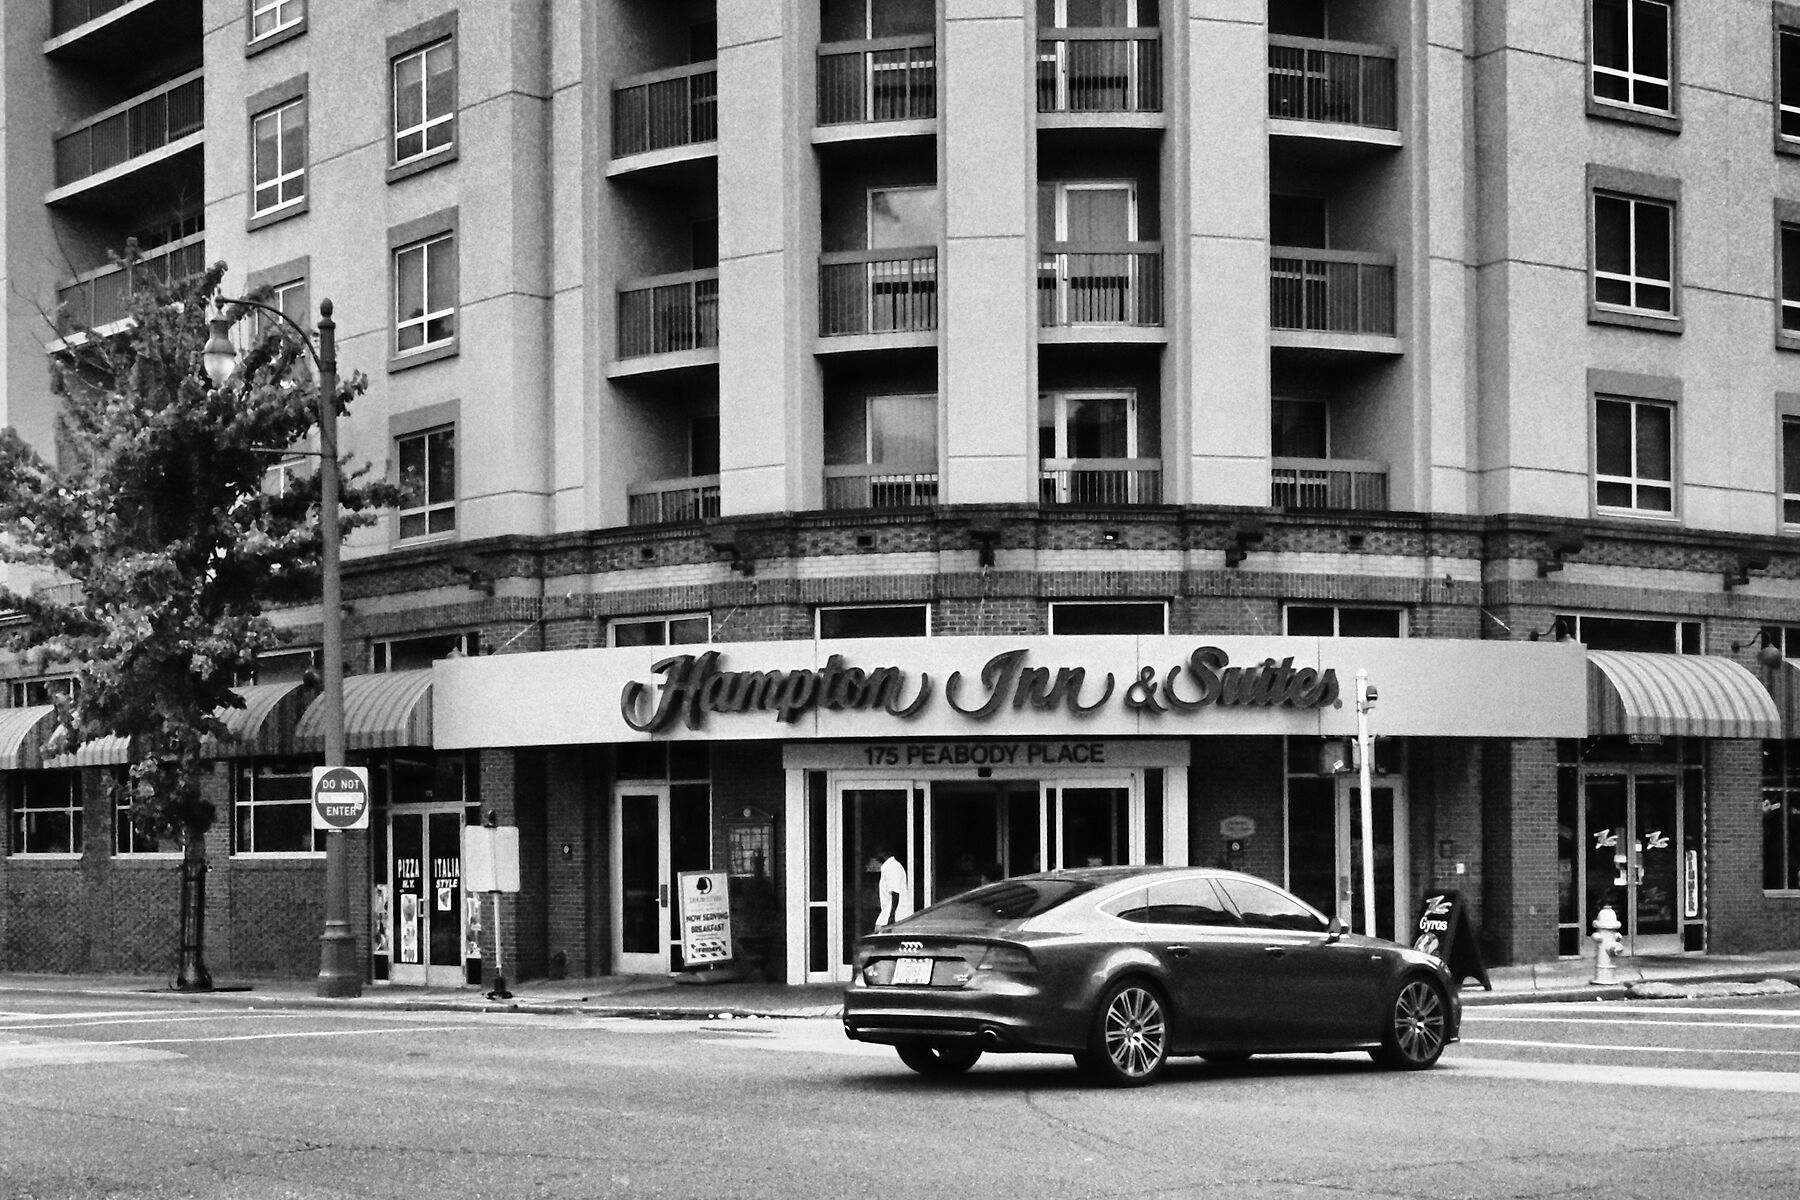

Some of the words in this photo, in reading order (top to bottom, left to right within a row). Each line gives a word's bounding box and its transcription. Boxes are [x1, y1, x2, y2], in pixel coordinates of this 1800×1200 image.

[622, 650, 931, 732] Hampton
[946, 648, 1115, 718] Inn
[1125, 665, 1169, 714] &
[1166, 645, 1342, 710] Suites
[865, 746, 899, 766] 175
[906, 744, 1020, 765] PEABODY
[1027, 743, 1105, 764] PLACE
[322, 779, 336, 790] DO
[341, 779, 360, 790] NOT
[326, 806, 357, 817] ENTER
[397, 858, 420, 878] PIZZA
[434, 857, 460, 878] ITALIA
[435, 878, 458, 889] STYLE
[686, 913, 702, 923] NOW
[702, 911, 729, 922] SERVING
[690, 923, 725, 934] BREAKFAST
[1419, 916, 1448, 933] Gyros
